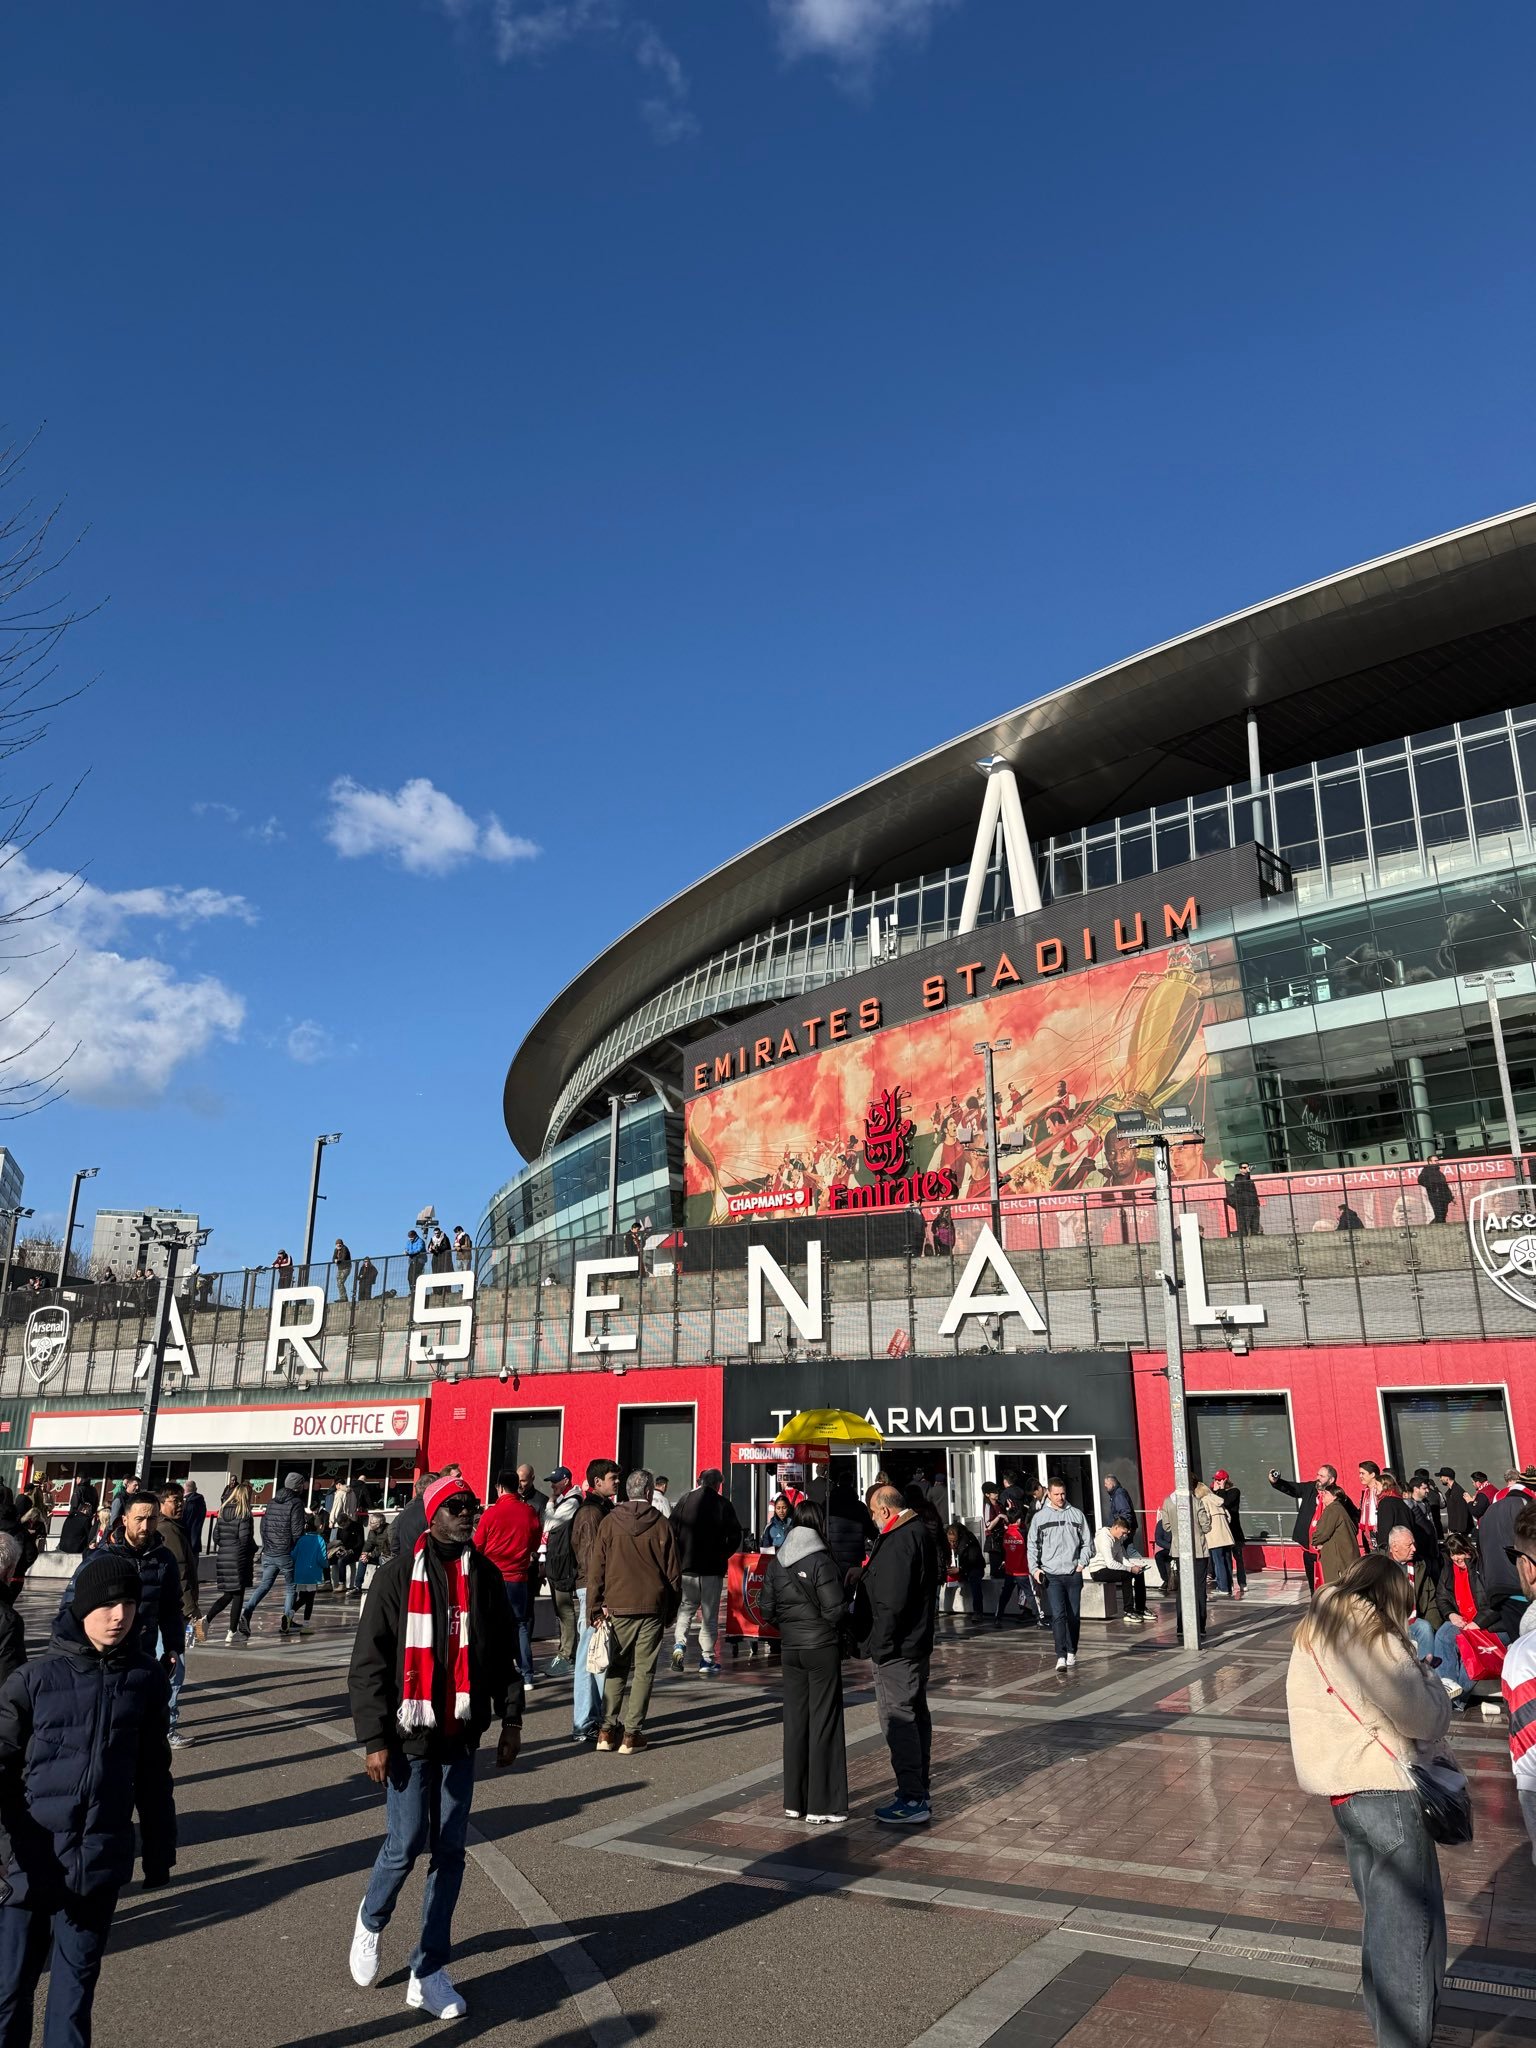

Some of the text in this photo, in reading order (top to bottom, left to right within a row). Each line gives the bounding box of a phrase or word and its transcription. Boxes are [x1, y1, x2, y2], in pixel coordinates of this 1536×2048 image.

[694, 896, 1197, 1091] EMIRATES STADIUM
[1305, 1160, 1506, 1186] OFFICIAL MERANDISE
[829, 1167, 953, 1210] Emirates
[730, 1192, 794, 1212] CHAPMAN'S
[930, 1195, 1084, 1215] OICIAL ERCHANDIS
[31, 1320, 64, 1334] Arsenal
[293, 1413, 385, 1436] BOX OFFICE
[864, 1404, 1068, 1434] ARMOURY
[738, 1447, 795, 1460] PROGRAMMES
